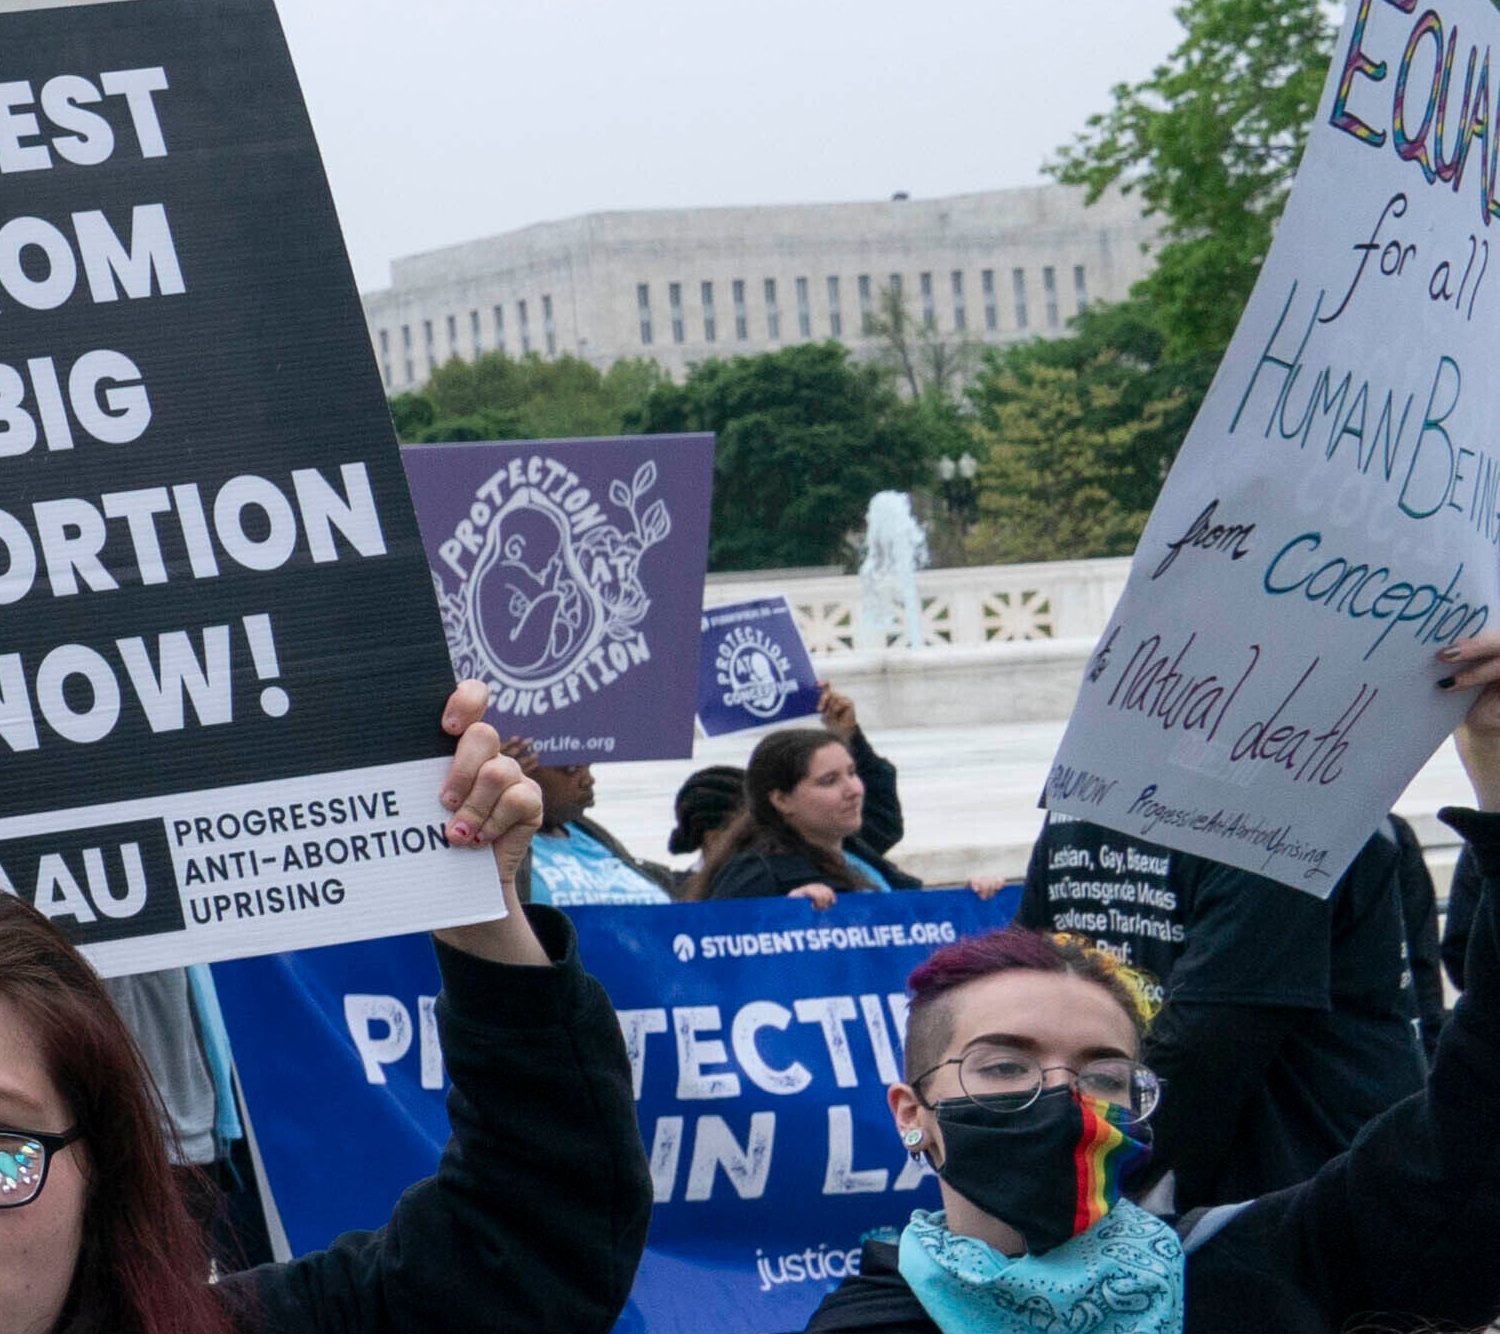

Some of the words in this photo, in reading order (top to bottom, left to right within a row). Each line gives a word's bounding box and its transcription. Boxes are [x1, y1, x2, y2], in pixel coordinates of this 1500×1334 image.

[1318, 193, 1417, 323] for
[1429, 234, 1489, 321] all
[1228, 279, 1415, 483] HUMAN
[439, 455, 607, 581] PROTECTION
[1152, 499, 1256, 581] from
[590, 556, 632, 584] AT
[486, 632, 651, 717] CONCEPTION
[1229, 656, 1379, 785] death
[174, 789, 401, 847] PROGRESSIVE
[184, 822, 451, 887] ANTI-ABORTION
[189, 878, 346, 925] UPRISING
[701, 921, 956, 958] STUDENTSFORLIFE.ORG
